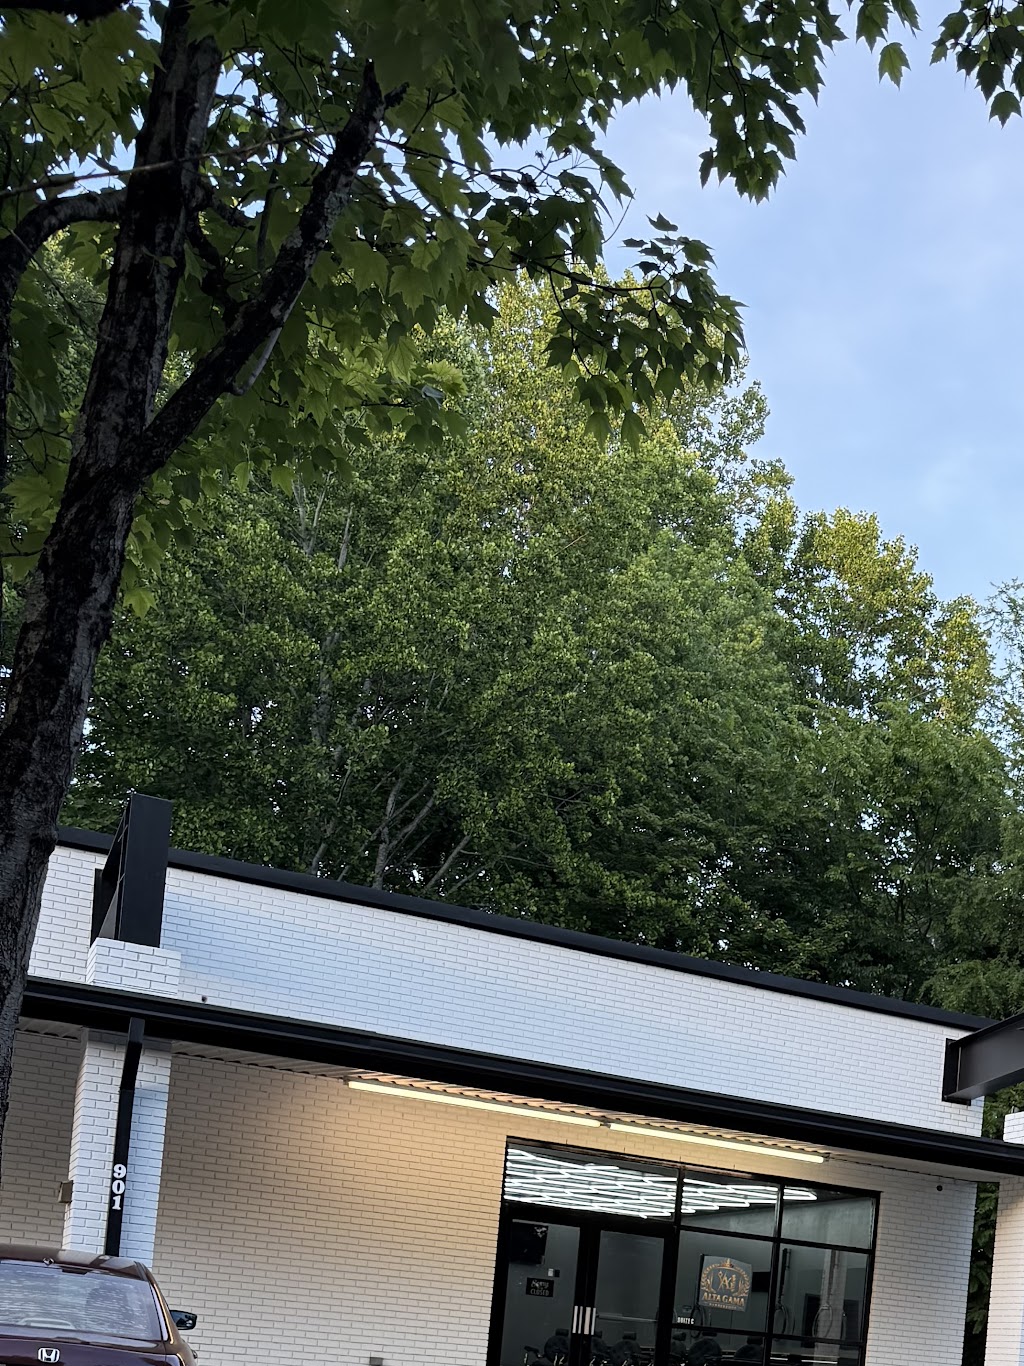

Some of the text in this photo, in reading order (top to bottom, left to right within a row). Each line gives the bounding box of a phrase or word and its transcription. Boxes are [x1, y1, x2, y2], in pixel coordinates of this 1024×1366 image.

[112, 1164, 127, 1210] 901
[702, 1292, 745, 1306] ALTA GAMA
